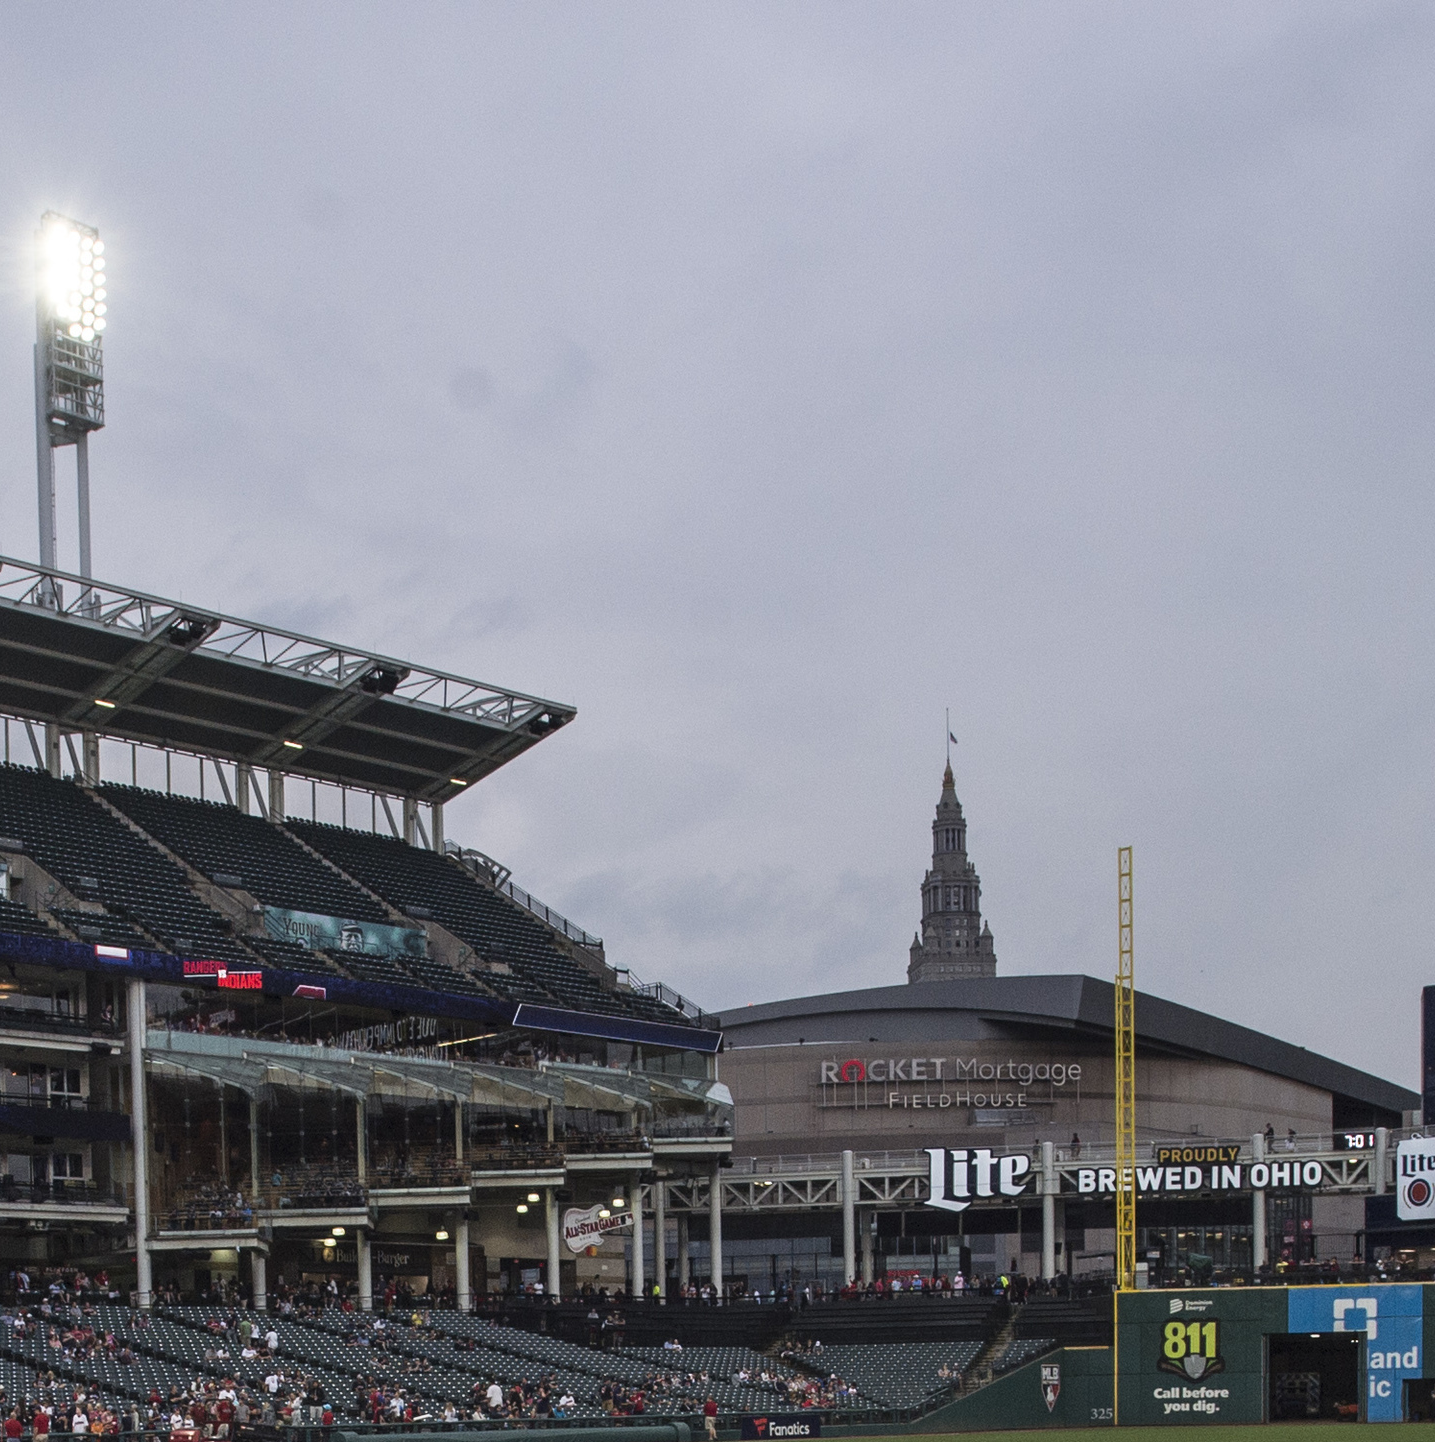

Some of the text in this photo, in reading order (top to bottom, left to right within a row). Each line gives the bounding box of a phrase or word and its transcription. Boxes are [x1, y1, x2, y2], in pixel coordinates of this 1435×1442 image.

[217, 973, 262, 989] INDIANS
[821, 1057, 1082, 1087] ROCKET Mortgage
[1345, 1134, 1374, 1148] 7:01
[1158, 1147, 1239, 1163] PROUDLY
[923, 1148, 1030, 1212] Lite
[1078, 1160, 1323, 1192] BREWED IN OHIO
[1164, 1322, 1216, 1359] 811
[1042, 1367, 1059, 1380] MLB
[1153, 1386, 1230, 1399] Call before
[1090, 1408, 1113, 1420] 325
[1164, 1400, 1220, 1414] you dig.
[769, 1421, 810, 1437] Fanatics
